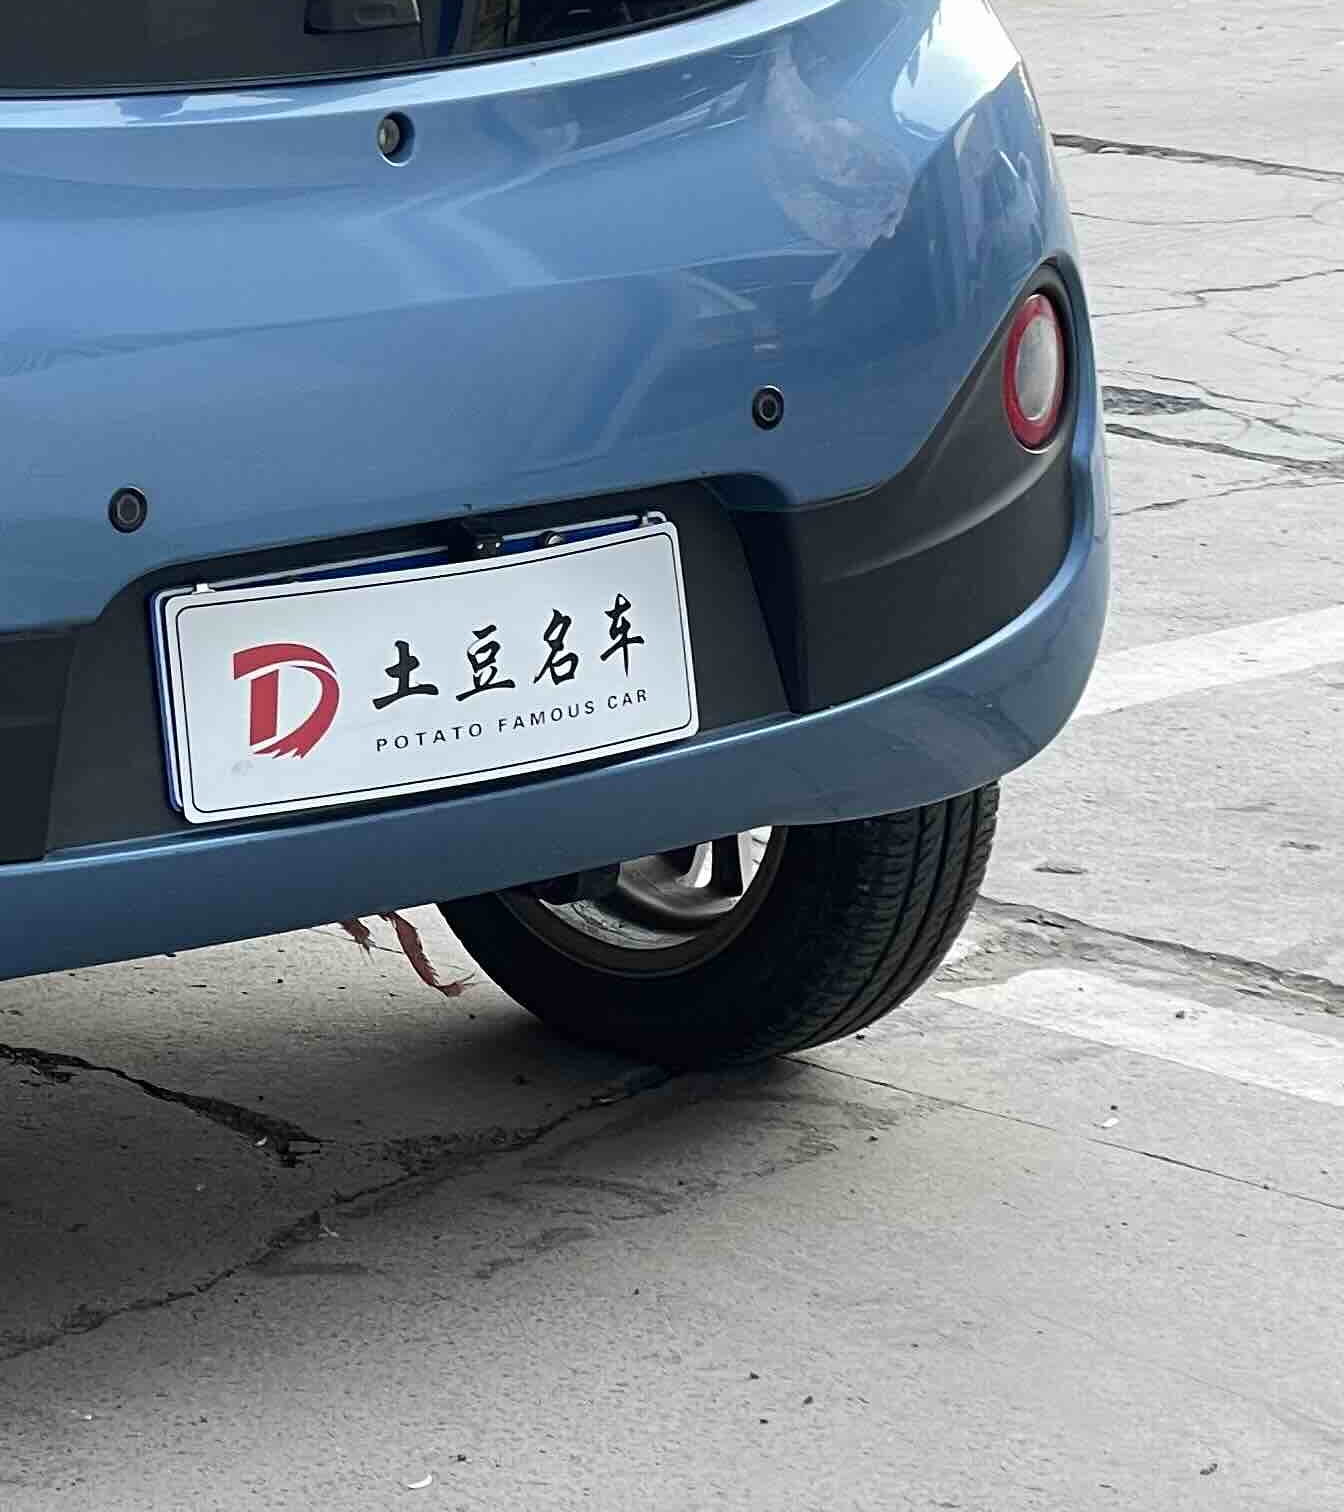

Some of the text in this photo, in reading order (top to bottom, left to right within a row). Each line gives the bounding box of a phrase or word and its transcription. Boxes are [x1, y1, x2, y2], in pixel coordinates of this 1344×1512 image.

[371, 592, 645, 711] 土豆名车
[375, 688, 649, 752] POTATO FAMOUS CAR
